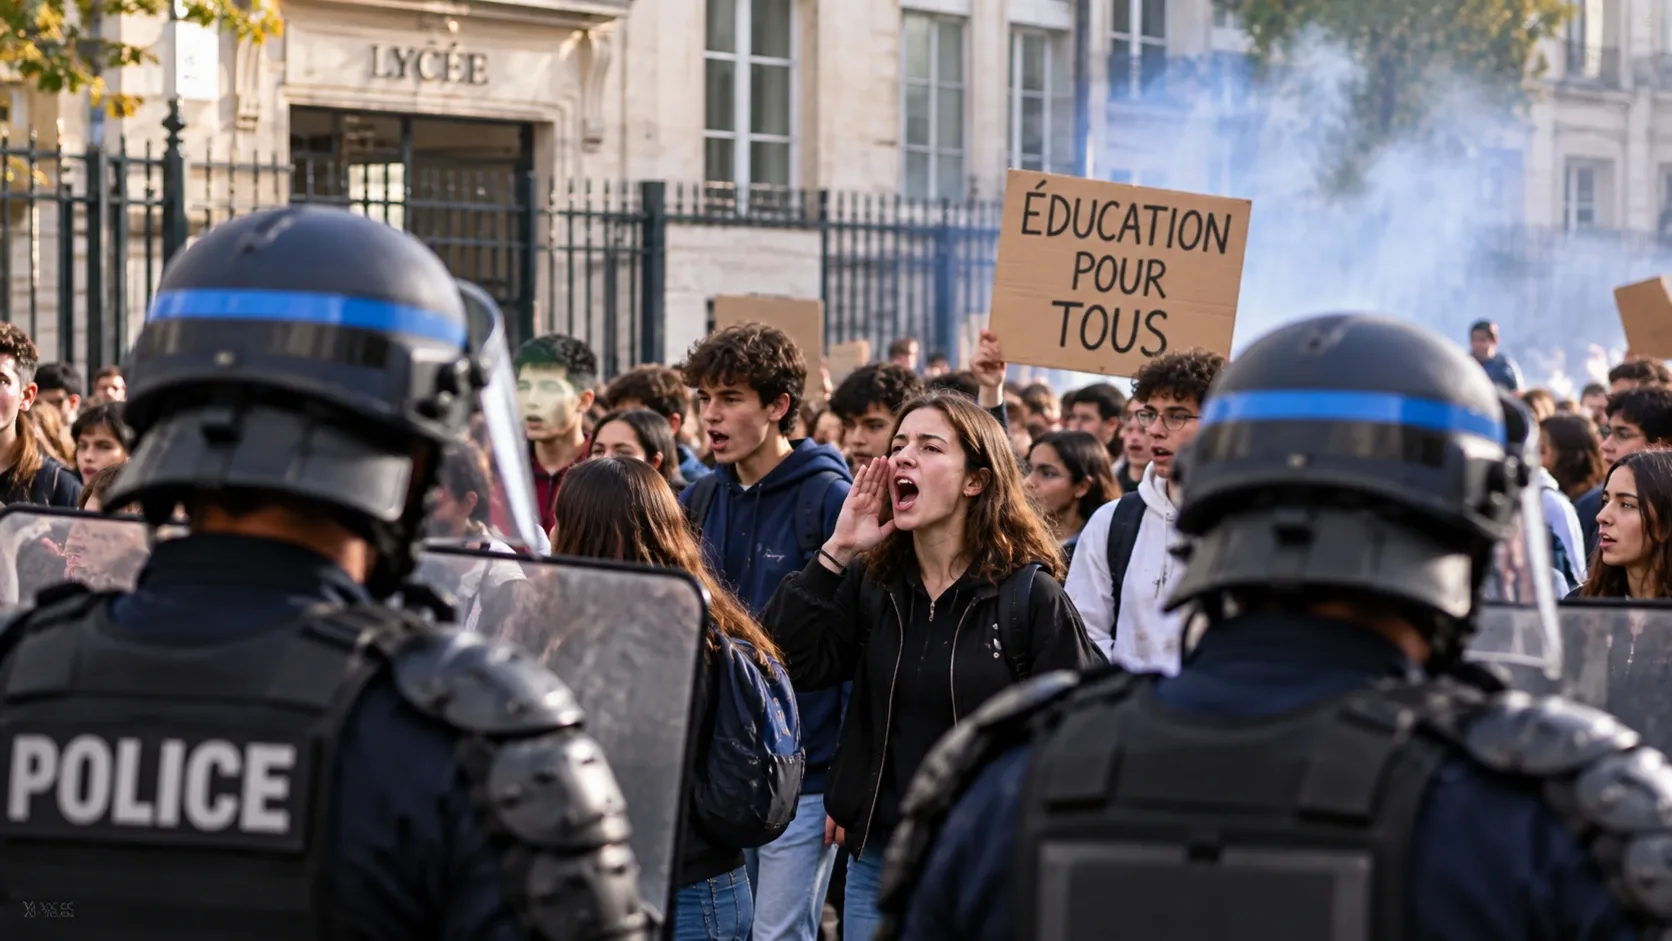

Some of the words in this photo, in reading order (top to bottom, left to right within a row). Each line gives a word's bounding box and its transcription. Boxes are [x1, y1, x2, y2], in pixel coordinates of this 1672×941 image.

[1021, 180, 1232, 254] ÉDUCATION
[1072, 251, 1166, 299] POUR
[1051, 300, 1168, 357] TOUS
[6, 733, 297, 834] POLICE
